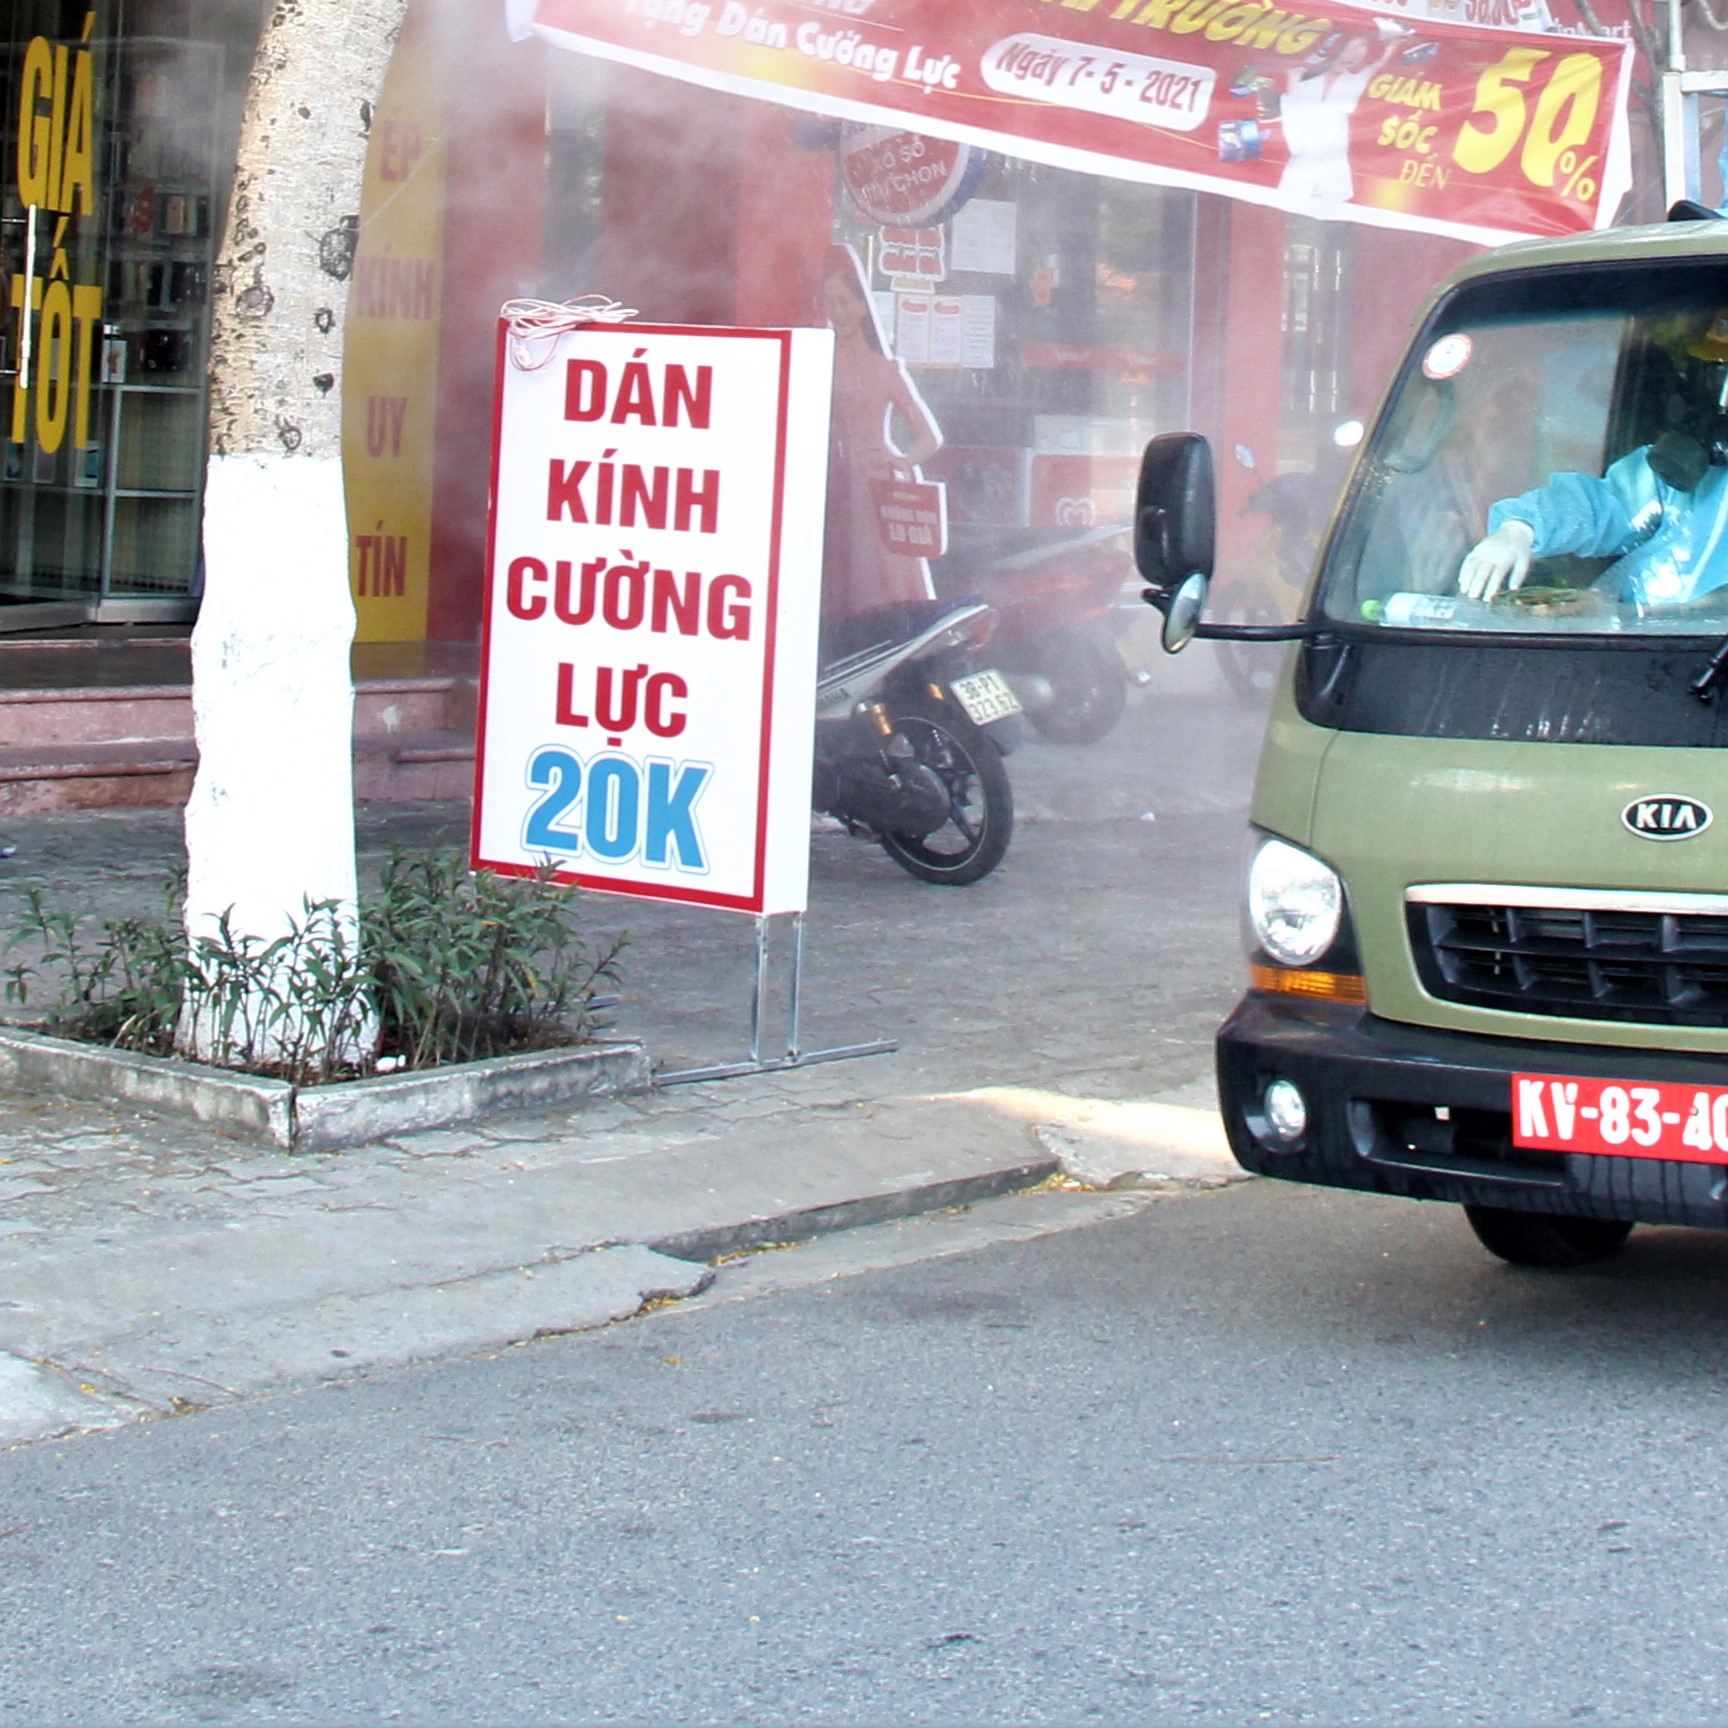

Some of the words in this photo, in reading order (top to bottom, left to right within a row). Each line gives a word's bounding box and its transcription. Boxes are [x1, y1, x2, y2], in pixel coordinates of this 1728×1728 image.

[715, 0, 789, 51] Dán
[903, 44, 962, 95] Lực
[17, 11, 94, 217] GIÁ
[1368, 71, 1443, 111] GIẢM
[1377, 110, 1439, 155] SỐC
[1399, 153, 1452, 191] ĐẾN
[356, 244, 435, 320] KÍNH
[11, 216, 102, 454] TỐT
[366, 396, 408, 459] UY
[563, 347, 713, 430] DÁN
[545, 448, 721, 534] KÍNH
[355, 521, 408, 599] TÍN
[506, 548, 753, 642] CƯỜNG
[555, 661, 688, 748] LỰC
[523, 745, 714, 874] 20K
[1635, 801, 1699, 831] KIA
